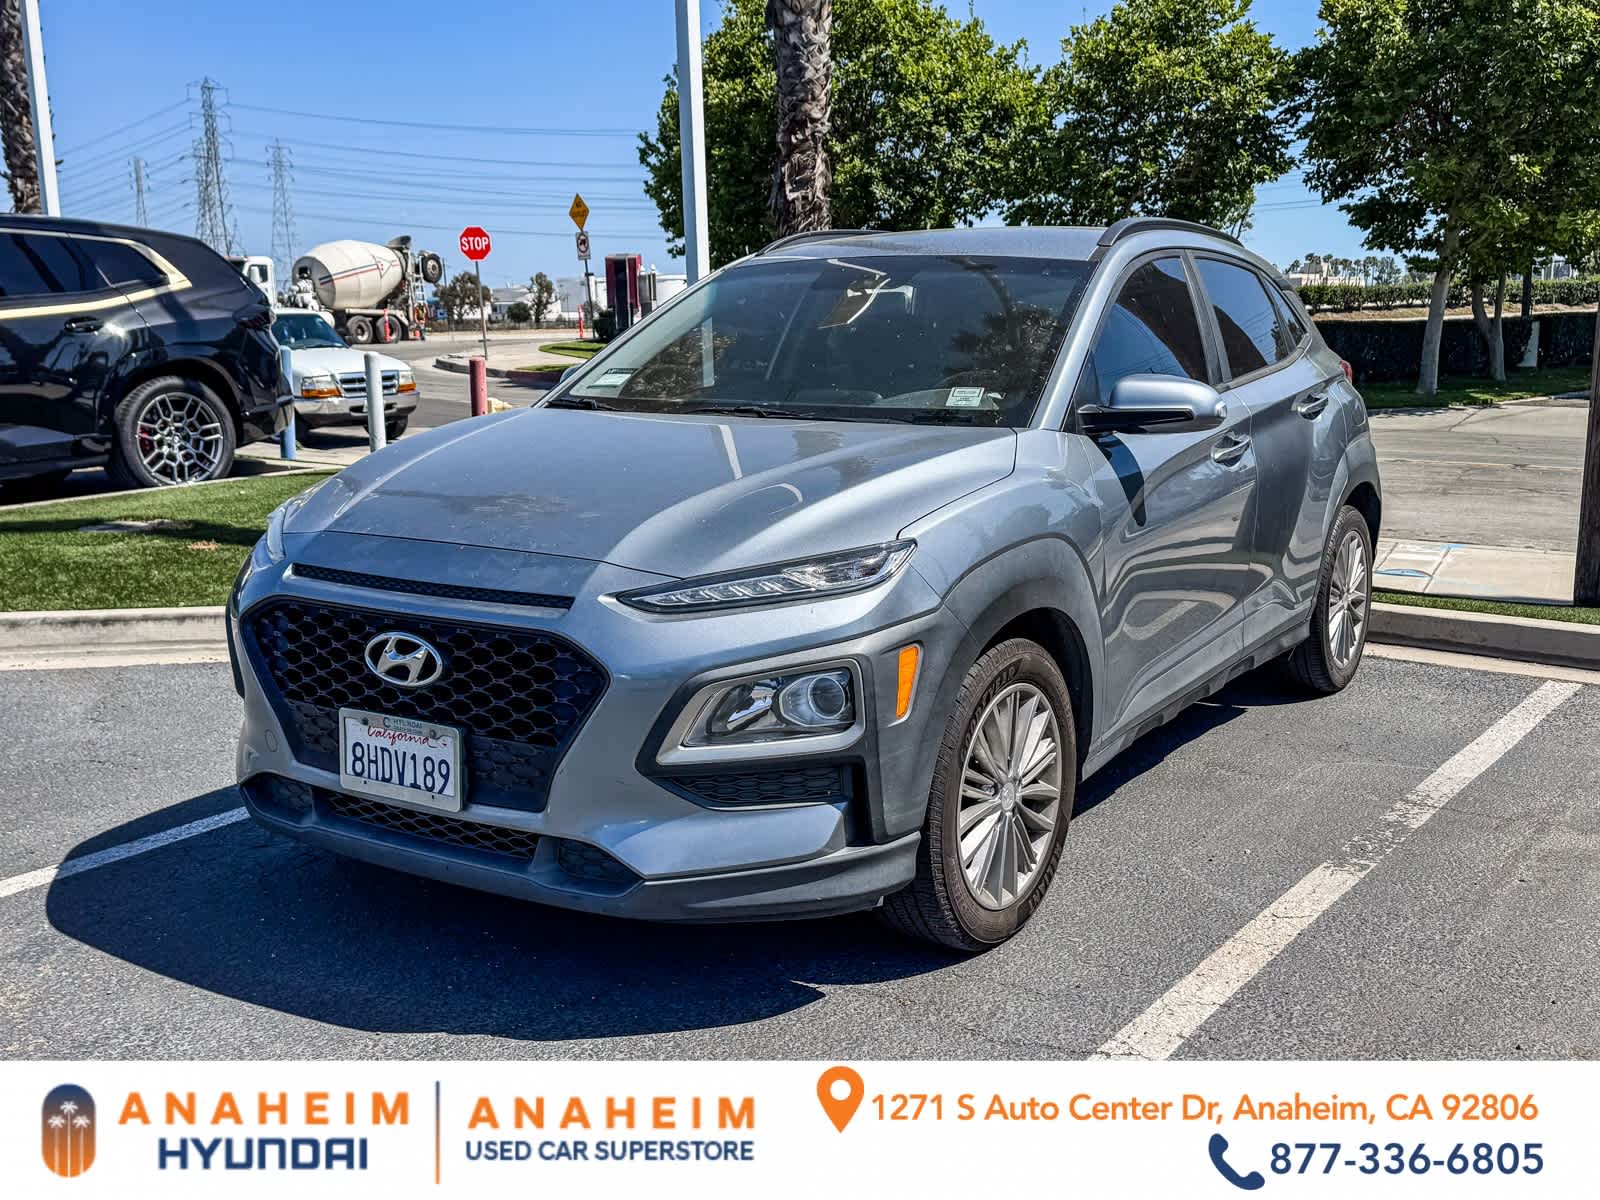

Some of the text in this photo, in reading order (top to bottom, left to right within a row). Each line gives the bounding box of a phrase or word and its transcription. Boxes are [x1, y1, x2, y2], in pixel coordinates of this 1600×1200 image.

[461, 235, 490, 252] STOP
[367, 724, 431, 746] California
[351, 741, 451, 795] 8HDV189
